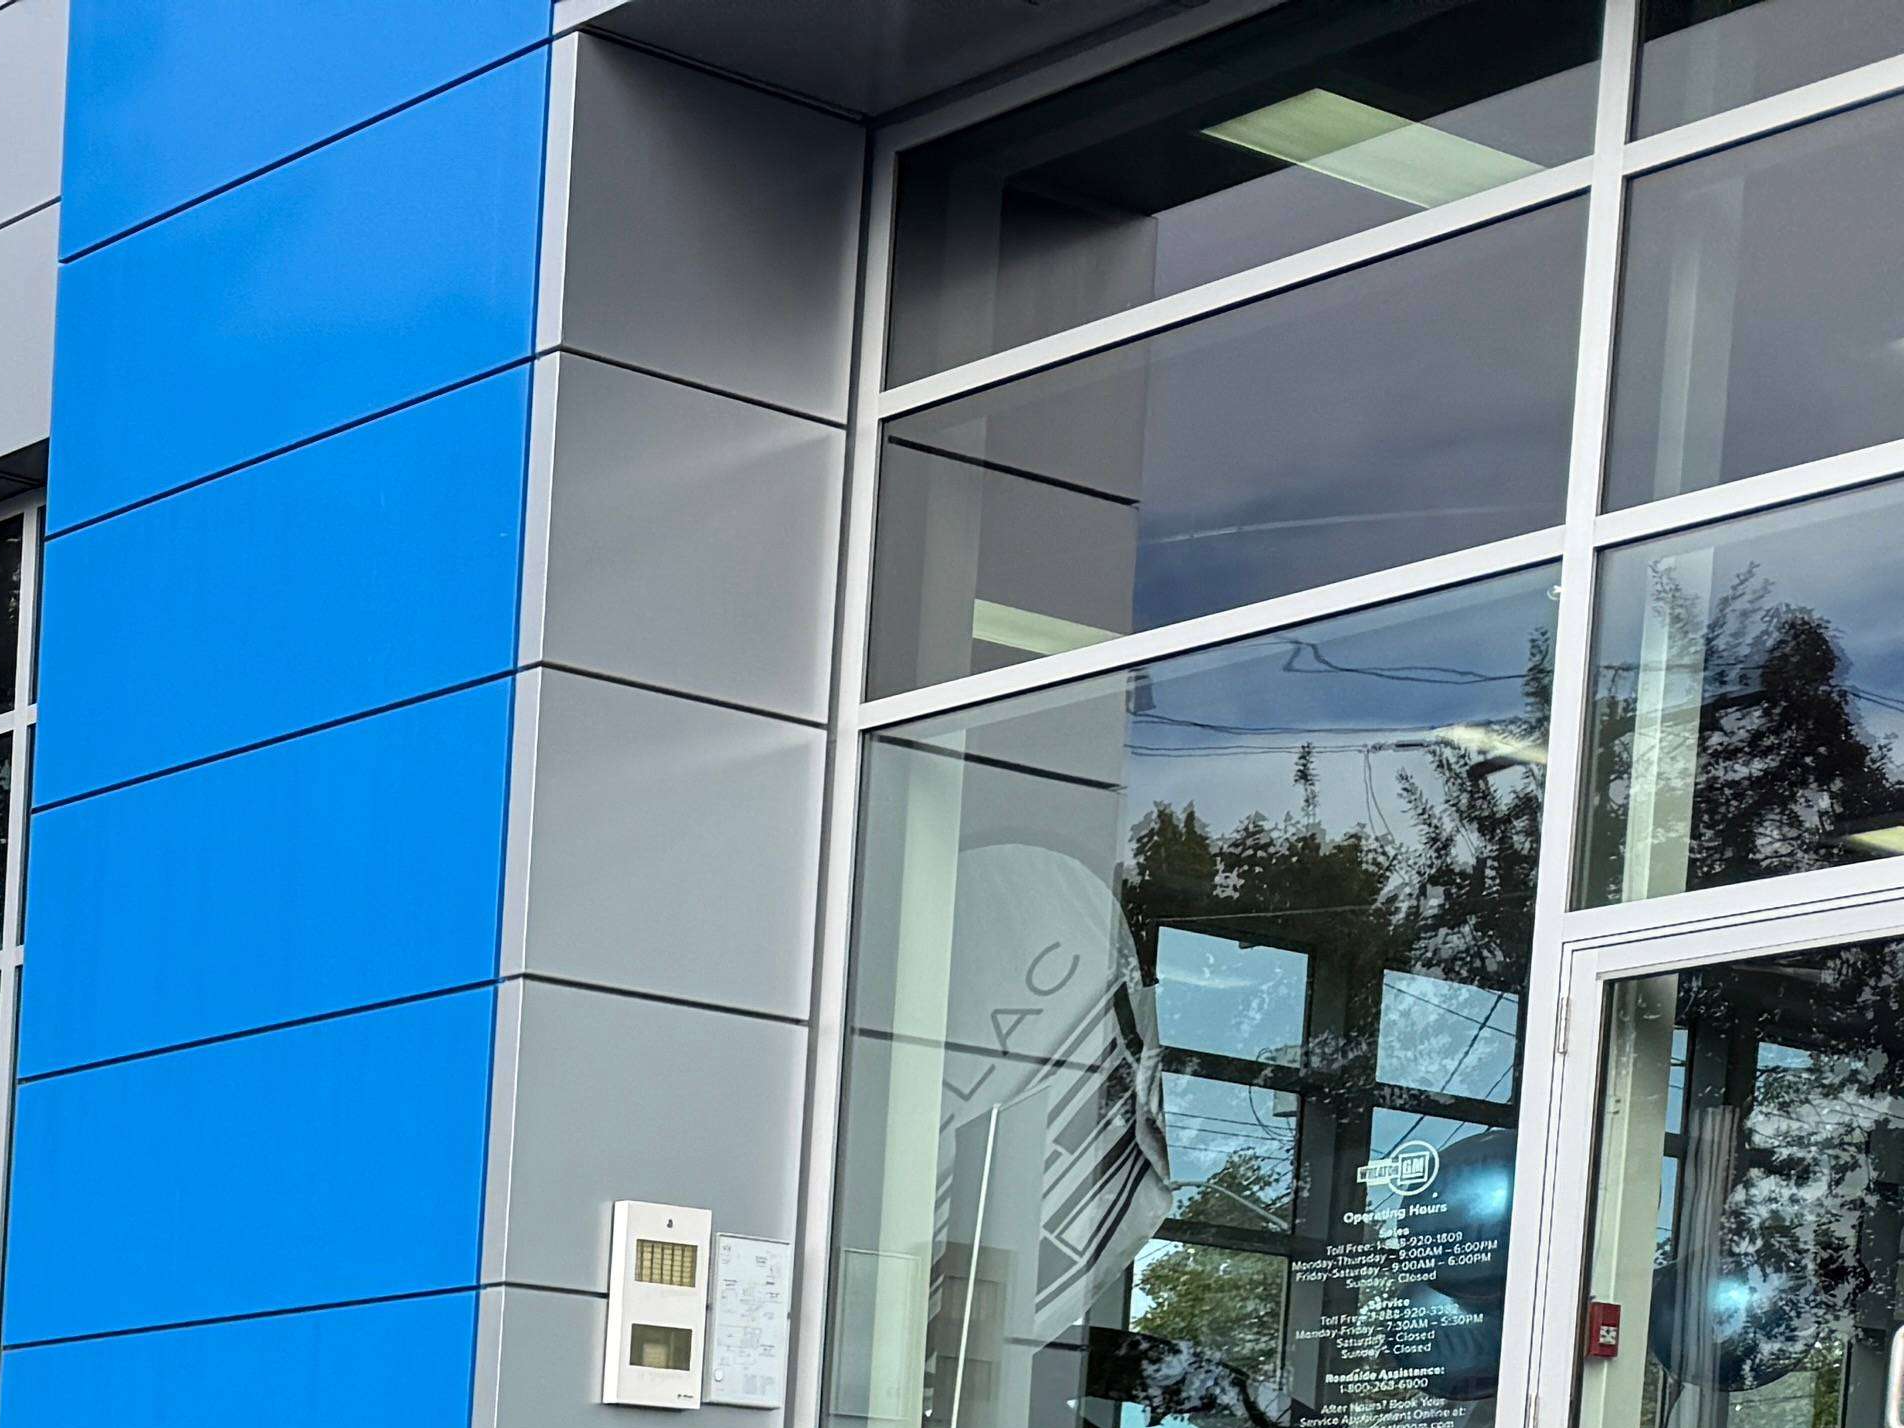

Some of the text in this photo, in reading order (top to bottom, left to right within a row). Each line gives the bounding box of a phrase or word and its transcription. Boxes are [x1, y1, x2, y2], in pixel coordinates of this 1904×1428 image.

[1403, 1157, 1425, 1174] GM
[1343, 1204, 1447, 1225] Operating Hours
[1326, 1245, 1344, 1256] Toll
[1398, 1270, 1437, 1283] Closed
[1396, 1330, 1435, 1342] Closed
[1393, 1343, 1432, 1355] Closed
[1325, 1366, 1445, 1383] Roadside Assistance:
[1299, 1416, 1340, 1428] Service
